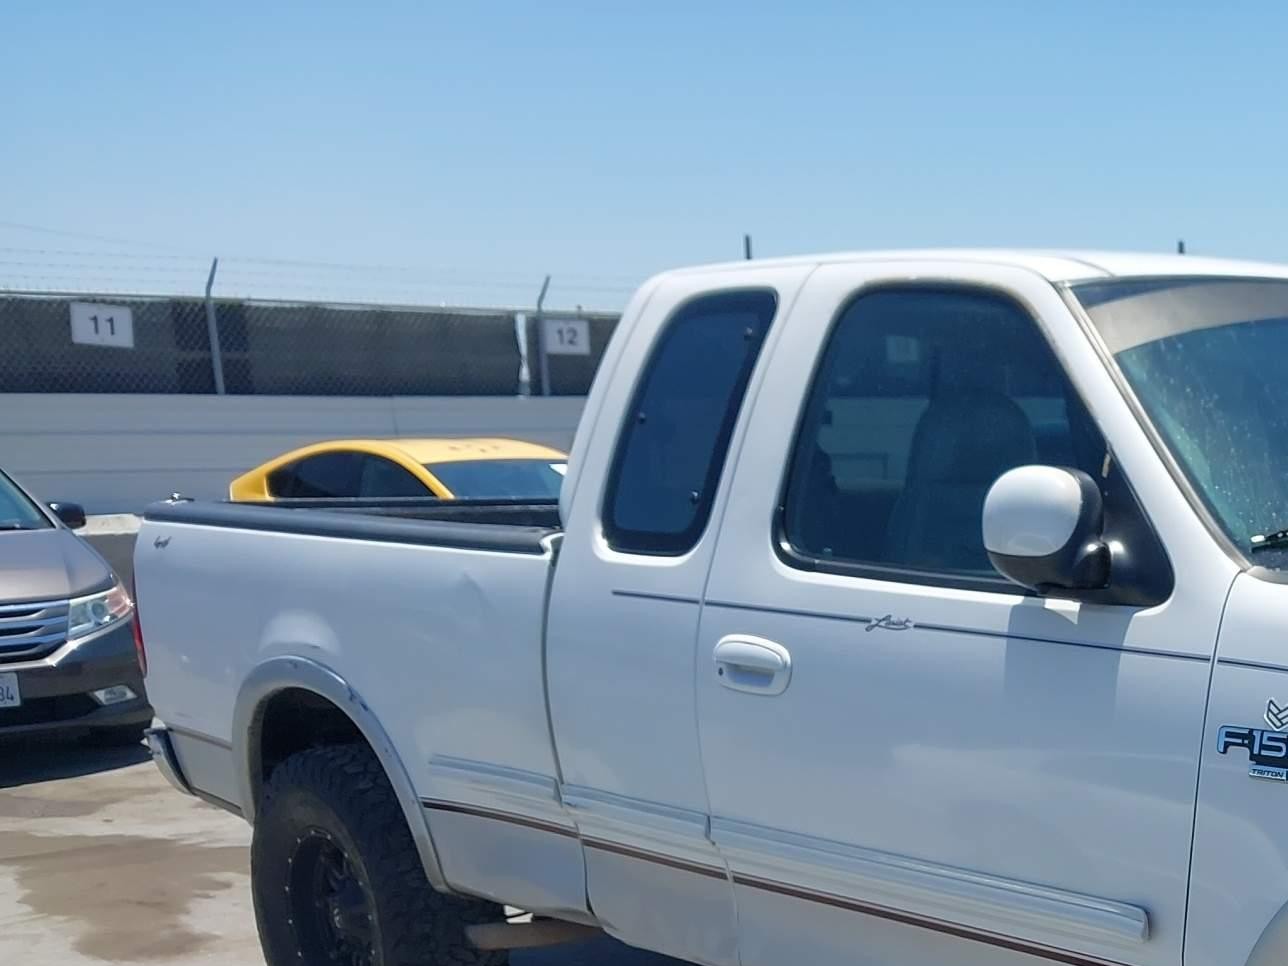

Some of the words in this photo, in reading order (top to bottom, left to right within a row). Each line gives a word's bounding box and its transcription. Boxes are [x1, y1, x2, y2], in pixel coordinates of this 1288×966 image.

[88, 314, 116, 336] 11
[556, 326, 579, 346] 12
[1251, 767, 1284, 779] TRITON
